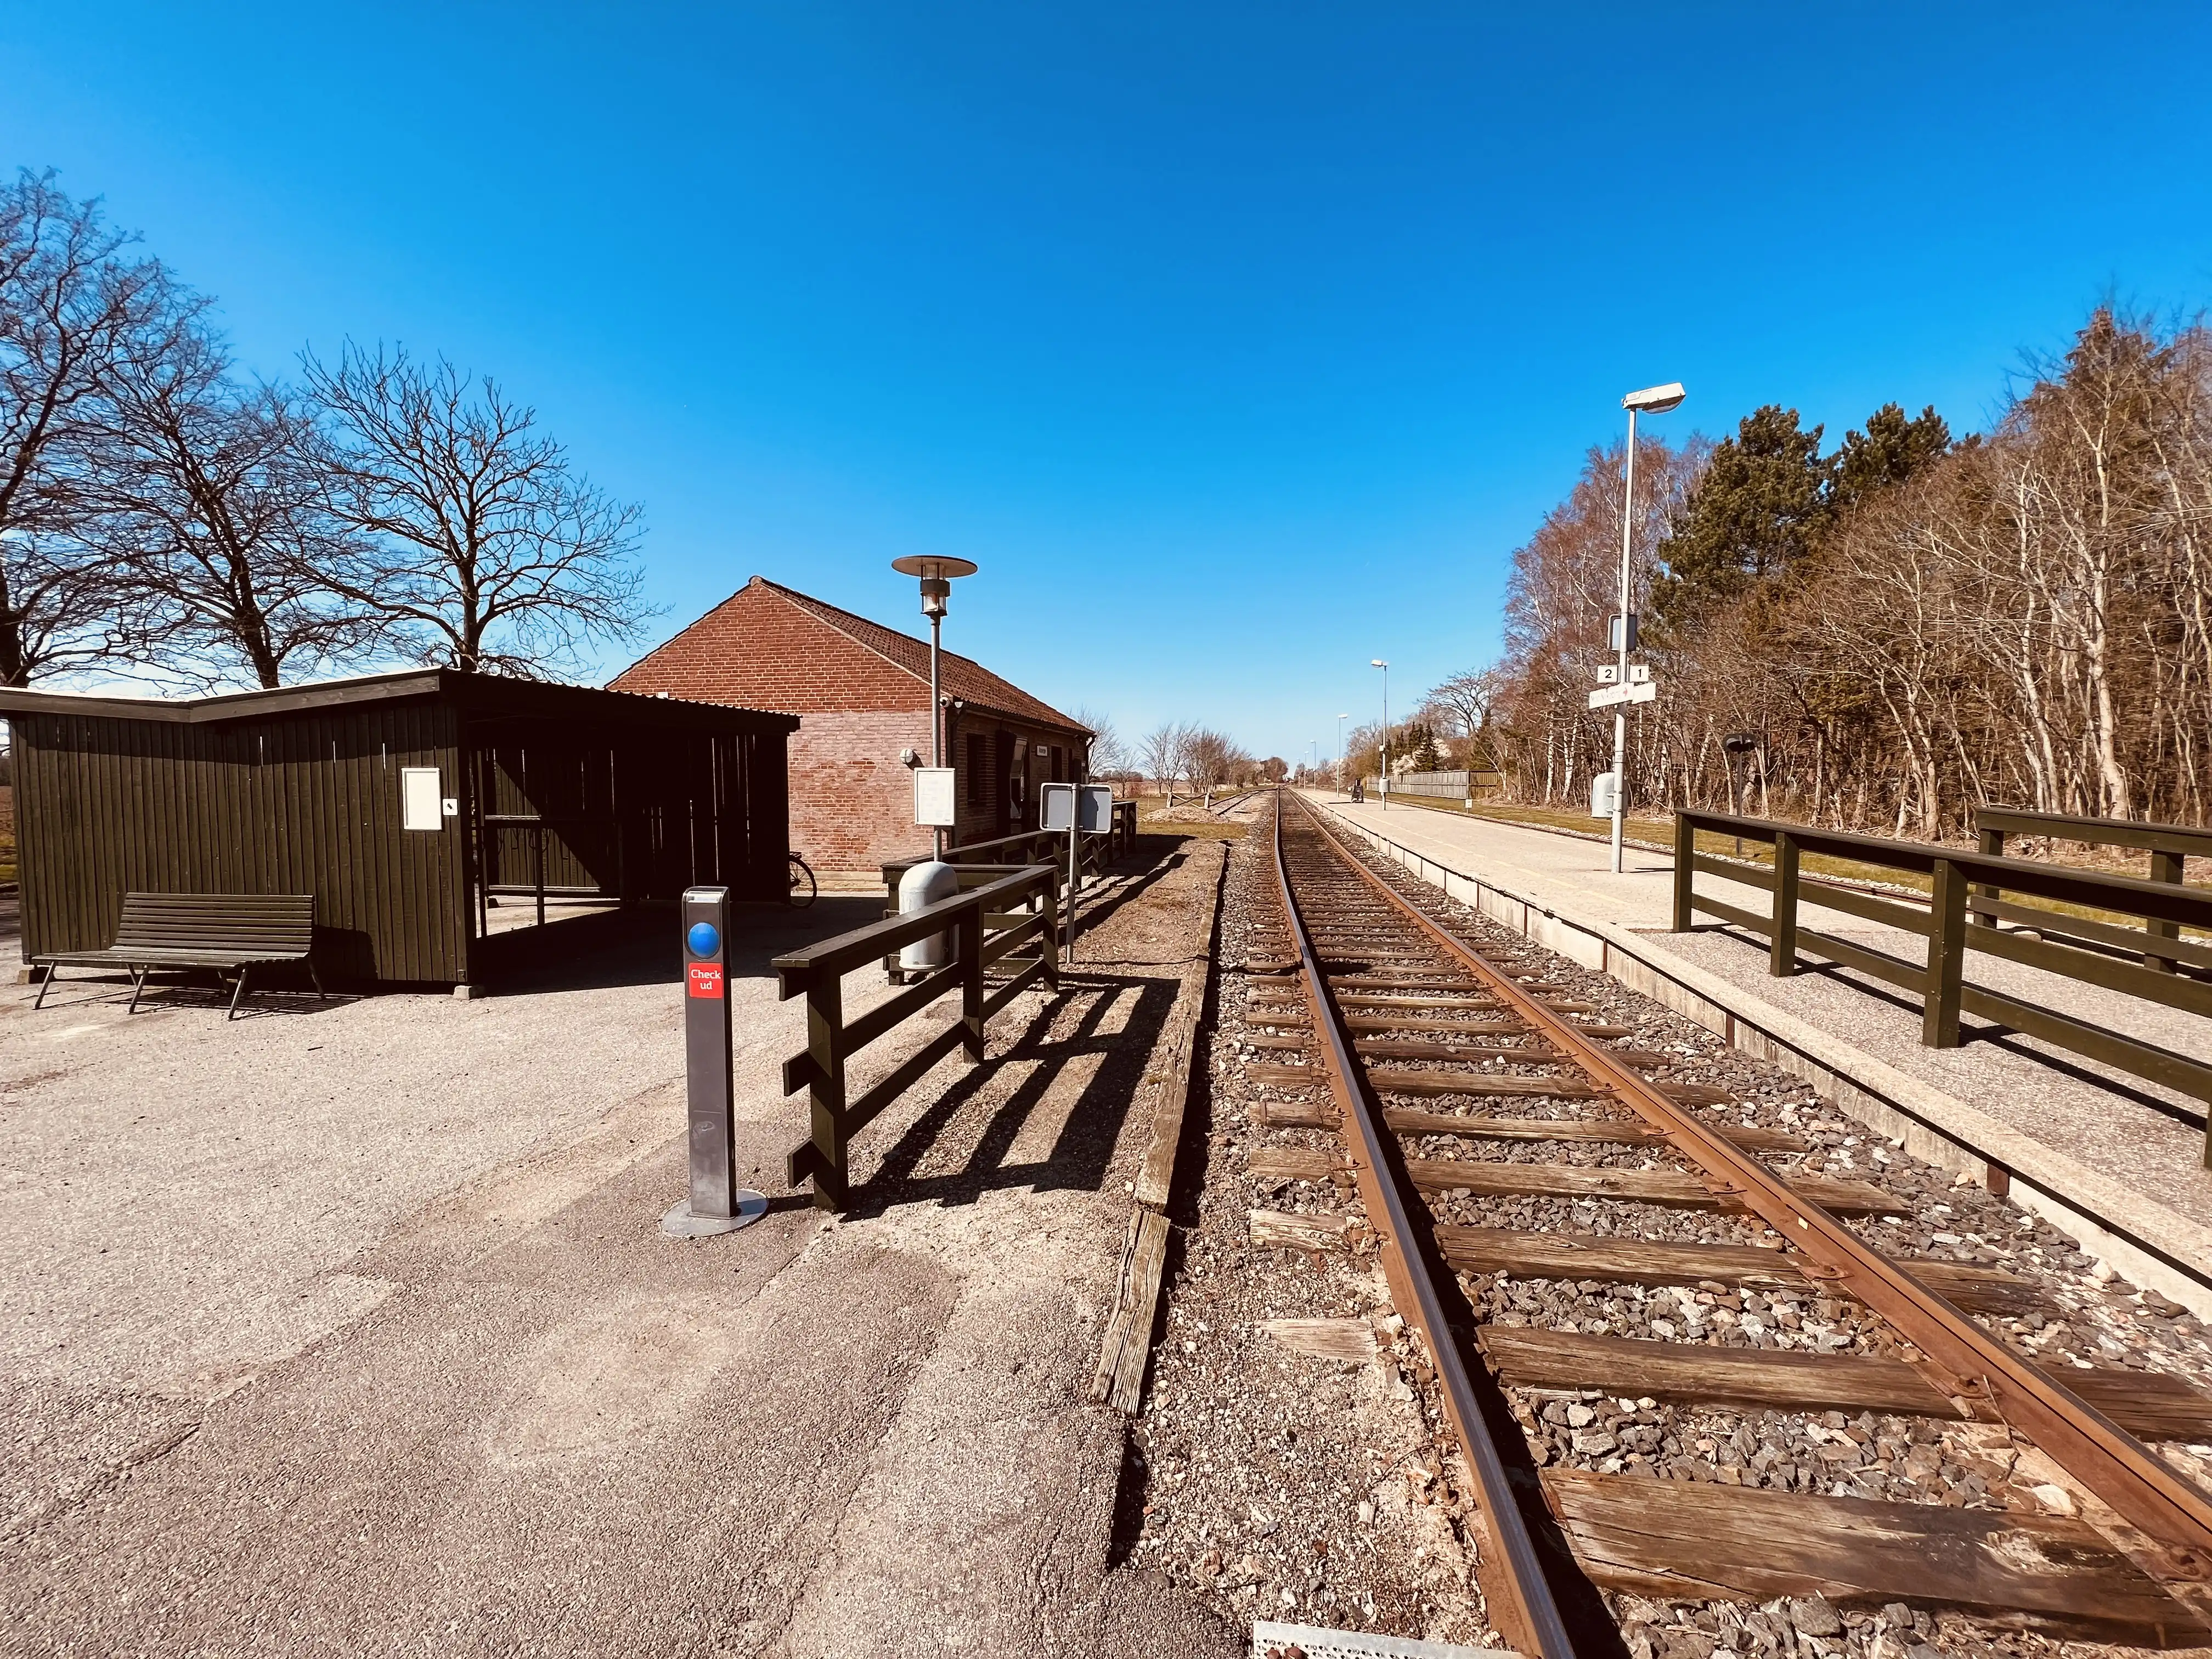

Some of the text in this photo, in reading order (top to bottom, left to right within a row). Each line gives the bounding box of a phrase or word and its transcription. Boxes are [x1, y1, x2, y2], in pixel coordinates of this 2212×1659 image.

[1605, 669, 1612, 679] 2
[1638, 668, 1642, 678] 1
[690, 969, 721, 979] Check
[700, 981, 713, 990] ud
